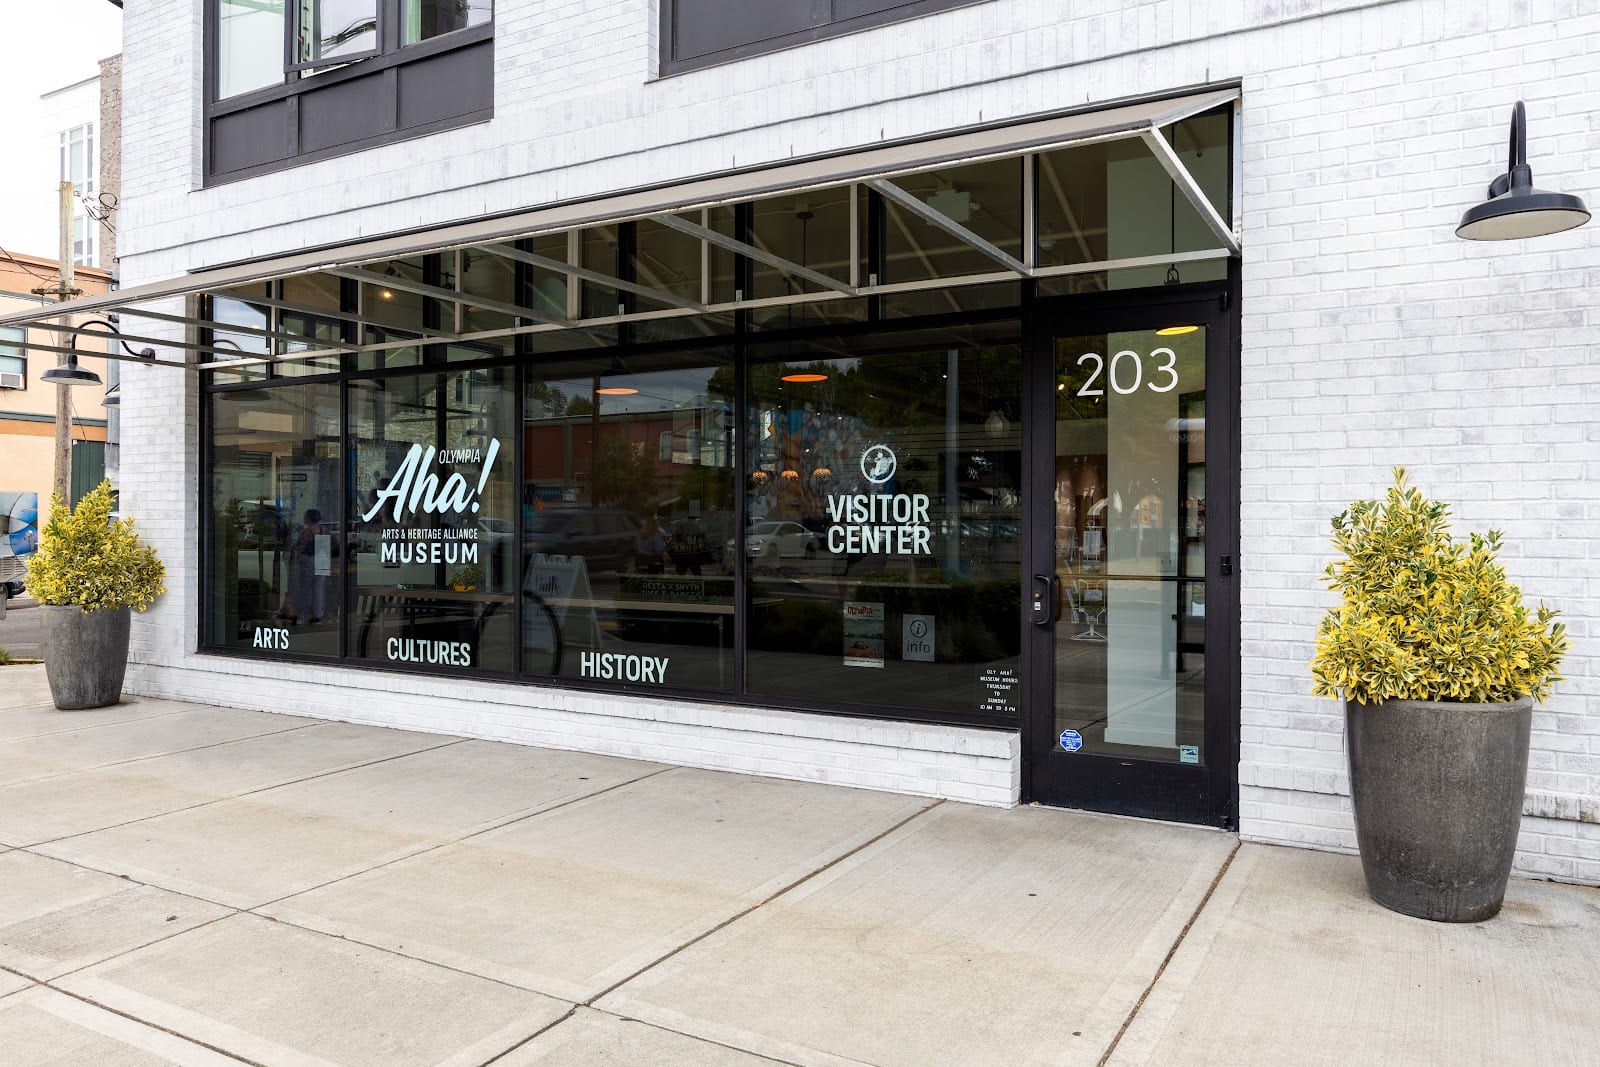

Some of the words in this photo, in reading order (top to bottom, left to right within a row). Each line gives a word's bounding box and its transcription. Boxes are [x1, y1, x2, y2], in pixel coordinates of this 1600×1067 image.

[1076, 347, 1179, 397] 203
[439, 449, 481, 465] OLYMPIA
[362, 437, 500, 523] Aha!
[827, 493, 931, 523] VISITOR
[381, 528, 400, 540] ARTS
[401, 528, 406, 540] &
[407, 528, 442, 540] HERITAGE
[443, 528, 478, 540] ALLIANCE
[827, 525, 932, 555] CENTER
[381, 542, 478, 564] MUSEUM
[252, 626, 289, 650] ARTS
[387, 637, 471, 666] CULTURES
[906, 641, 931, 653] info
[580, 651, 669, 684] HISTORY
